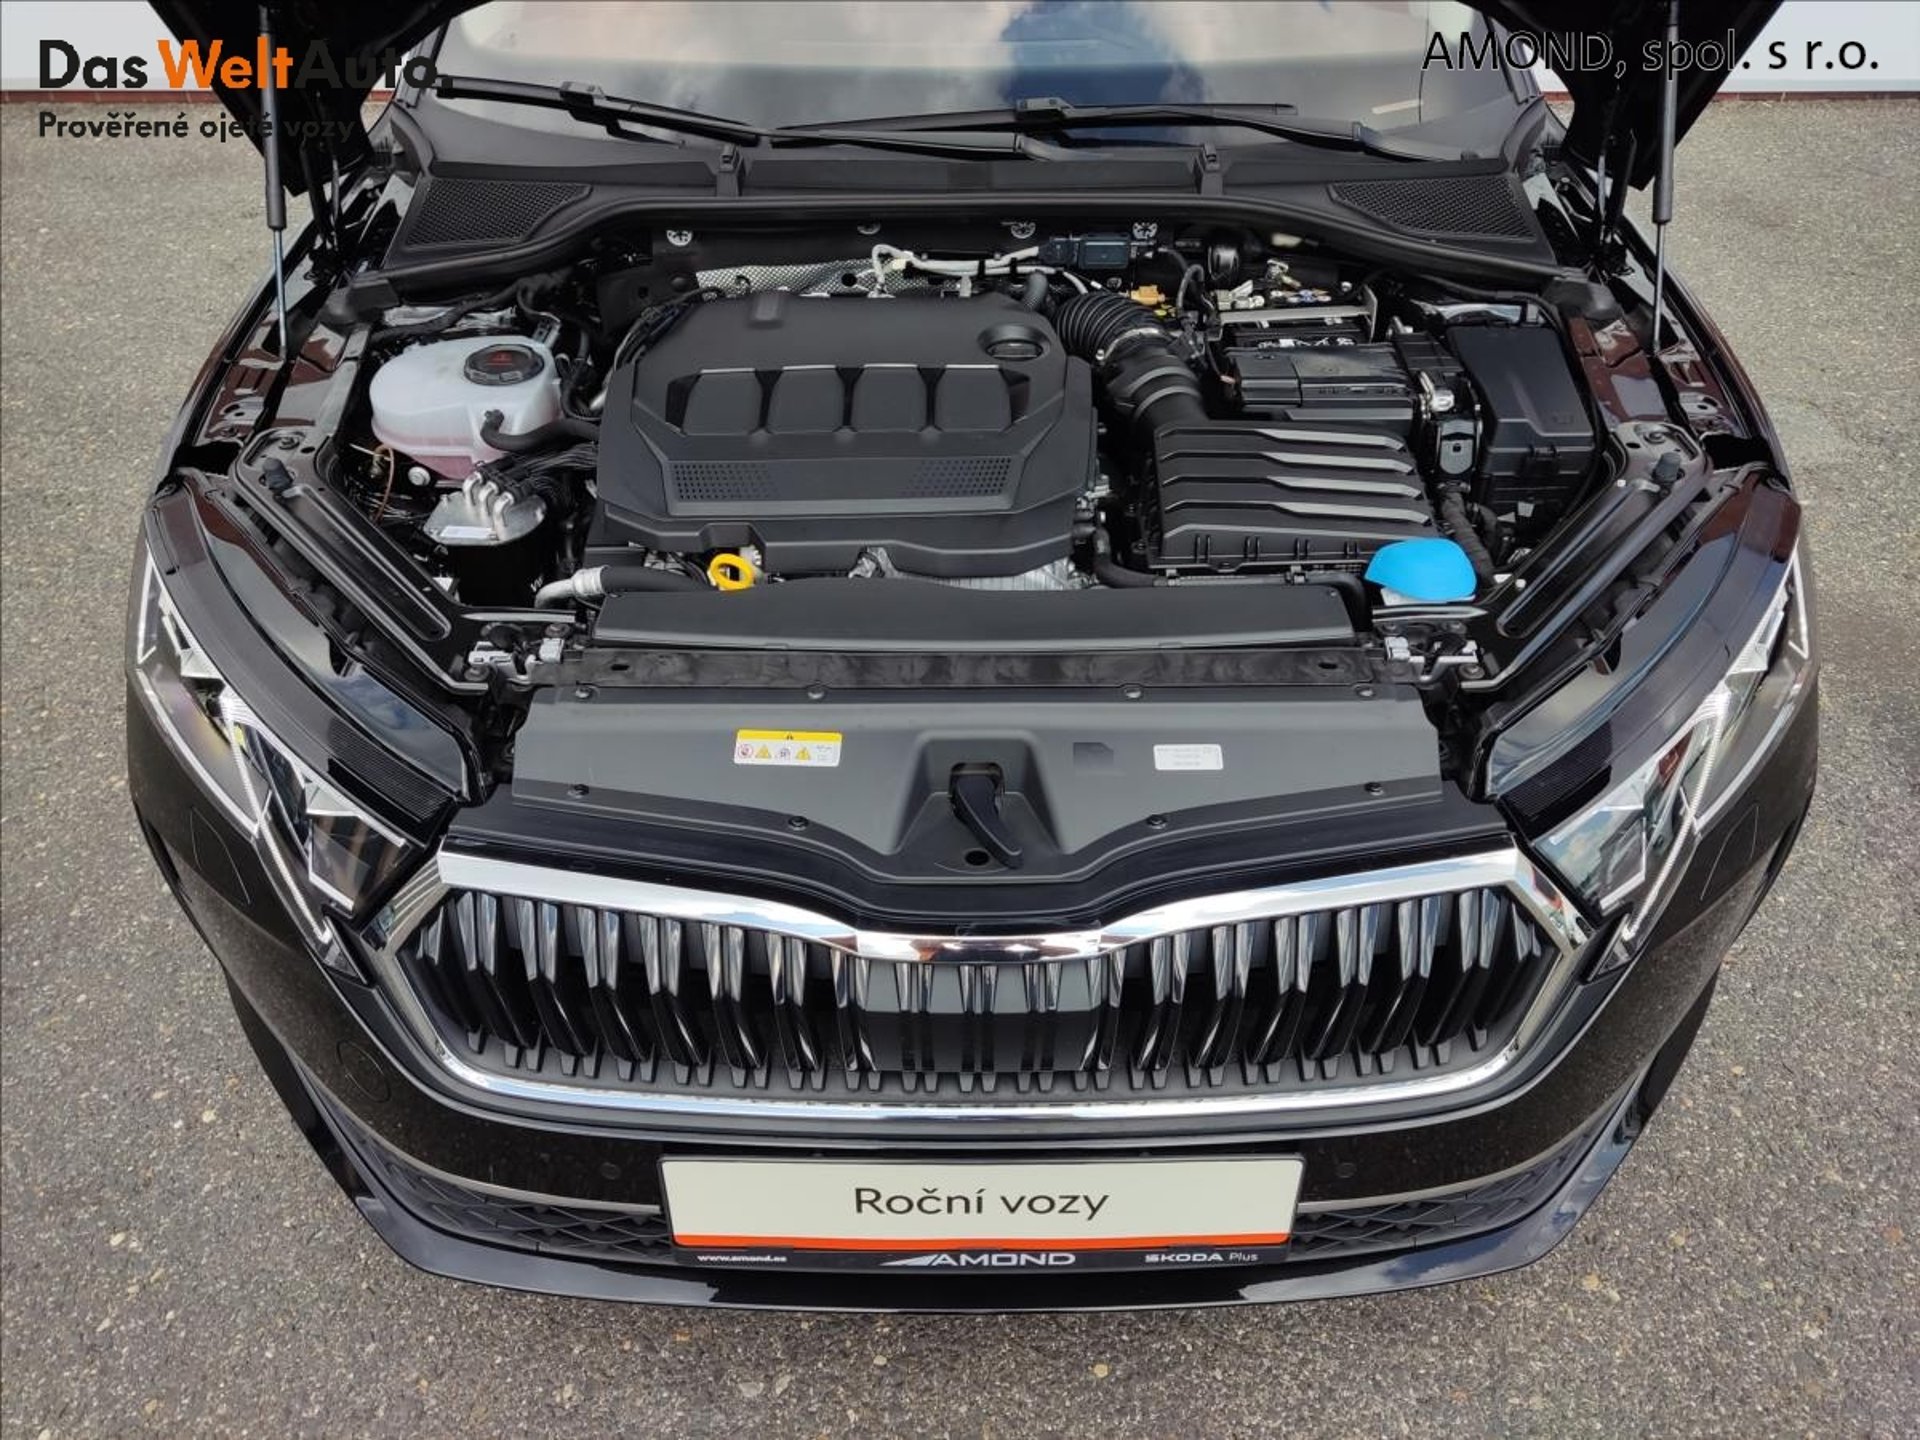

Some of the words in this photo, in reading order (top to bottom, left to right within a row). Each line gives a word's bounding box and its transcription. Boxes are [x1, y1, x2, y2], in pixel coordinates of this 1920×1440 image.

[854, 1187, 986, 1215] Roční
[1000, 1194, 1109, 1221] vozy
[931, 1252, 1076, 1267] AMOND
[1228, 1251, 1259, 1262] Plus
